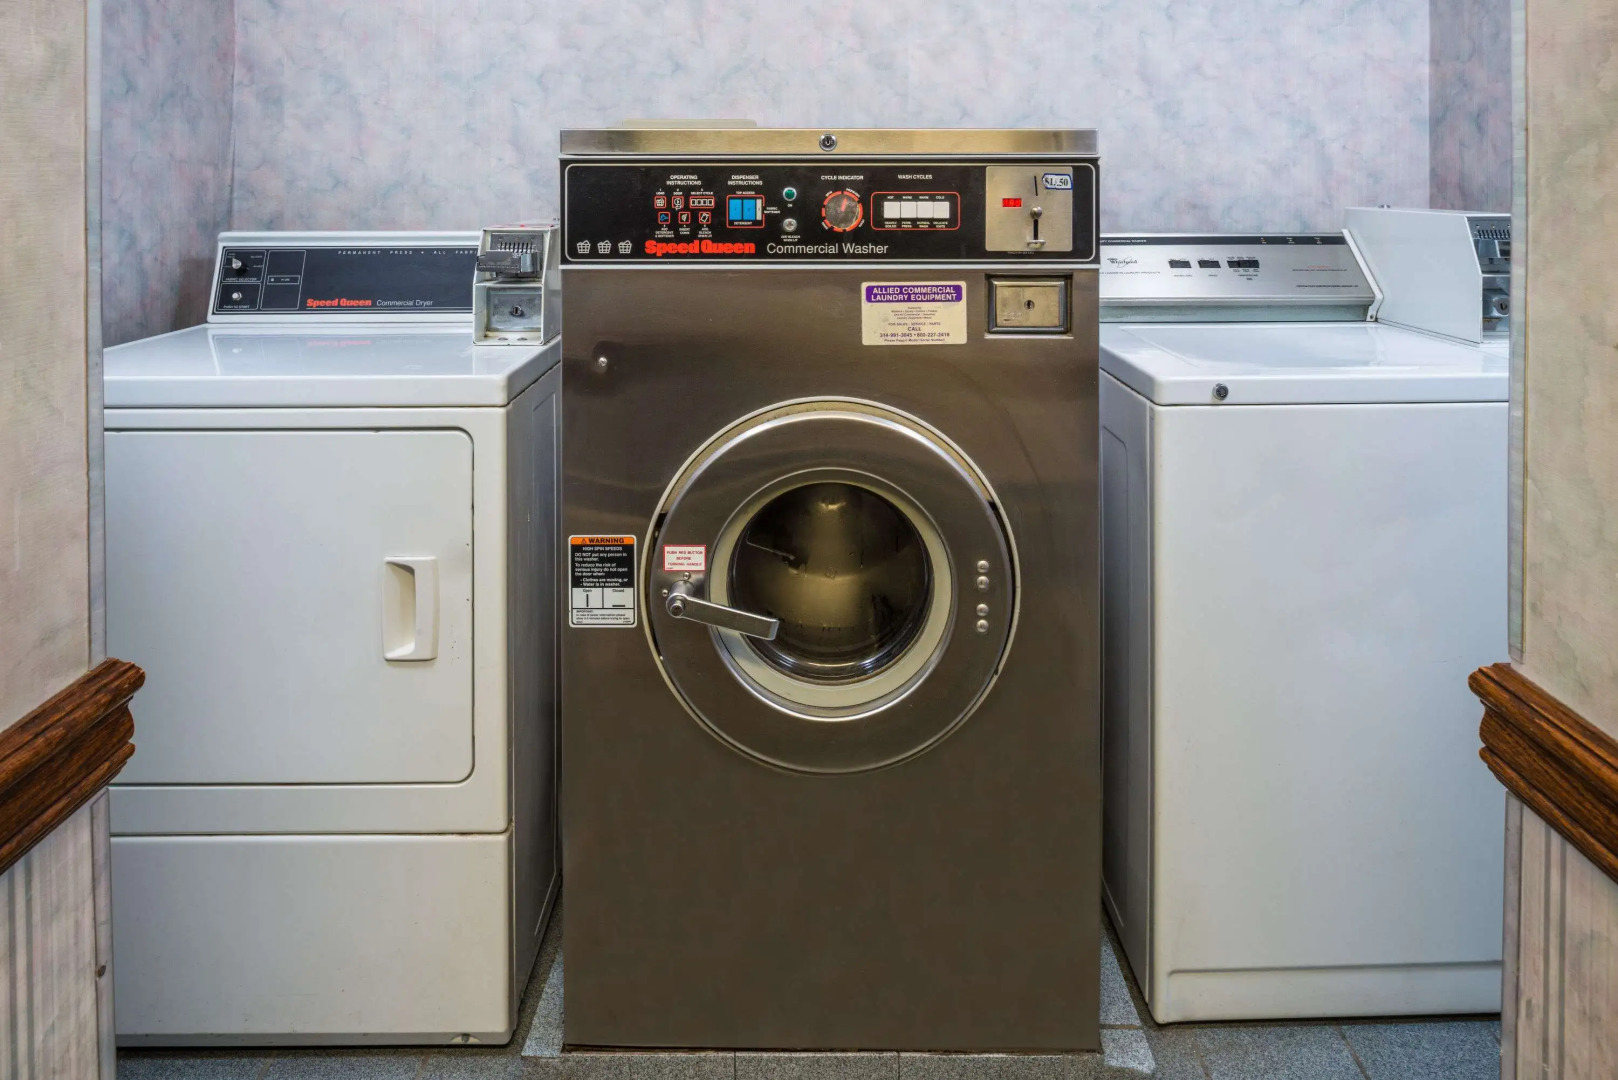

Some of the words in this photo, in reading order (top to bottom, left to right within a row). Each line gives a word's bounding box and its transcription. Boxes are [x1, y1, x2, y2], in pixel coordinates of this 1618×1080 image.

[645, 240, 699, 256] Speed
[700, 240, 756, 254] Queen
[766, 242, 838, 254] Commercial
[842, 242, 889, 254] Washer
[306, 298, 339, 308] Speed
[340, 298, 372, 307] Queen
[415, 299, 433, 307] Dryer
